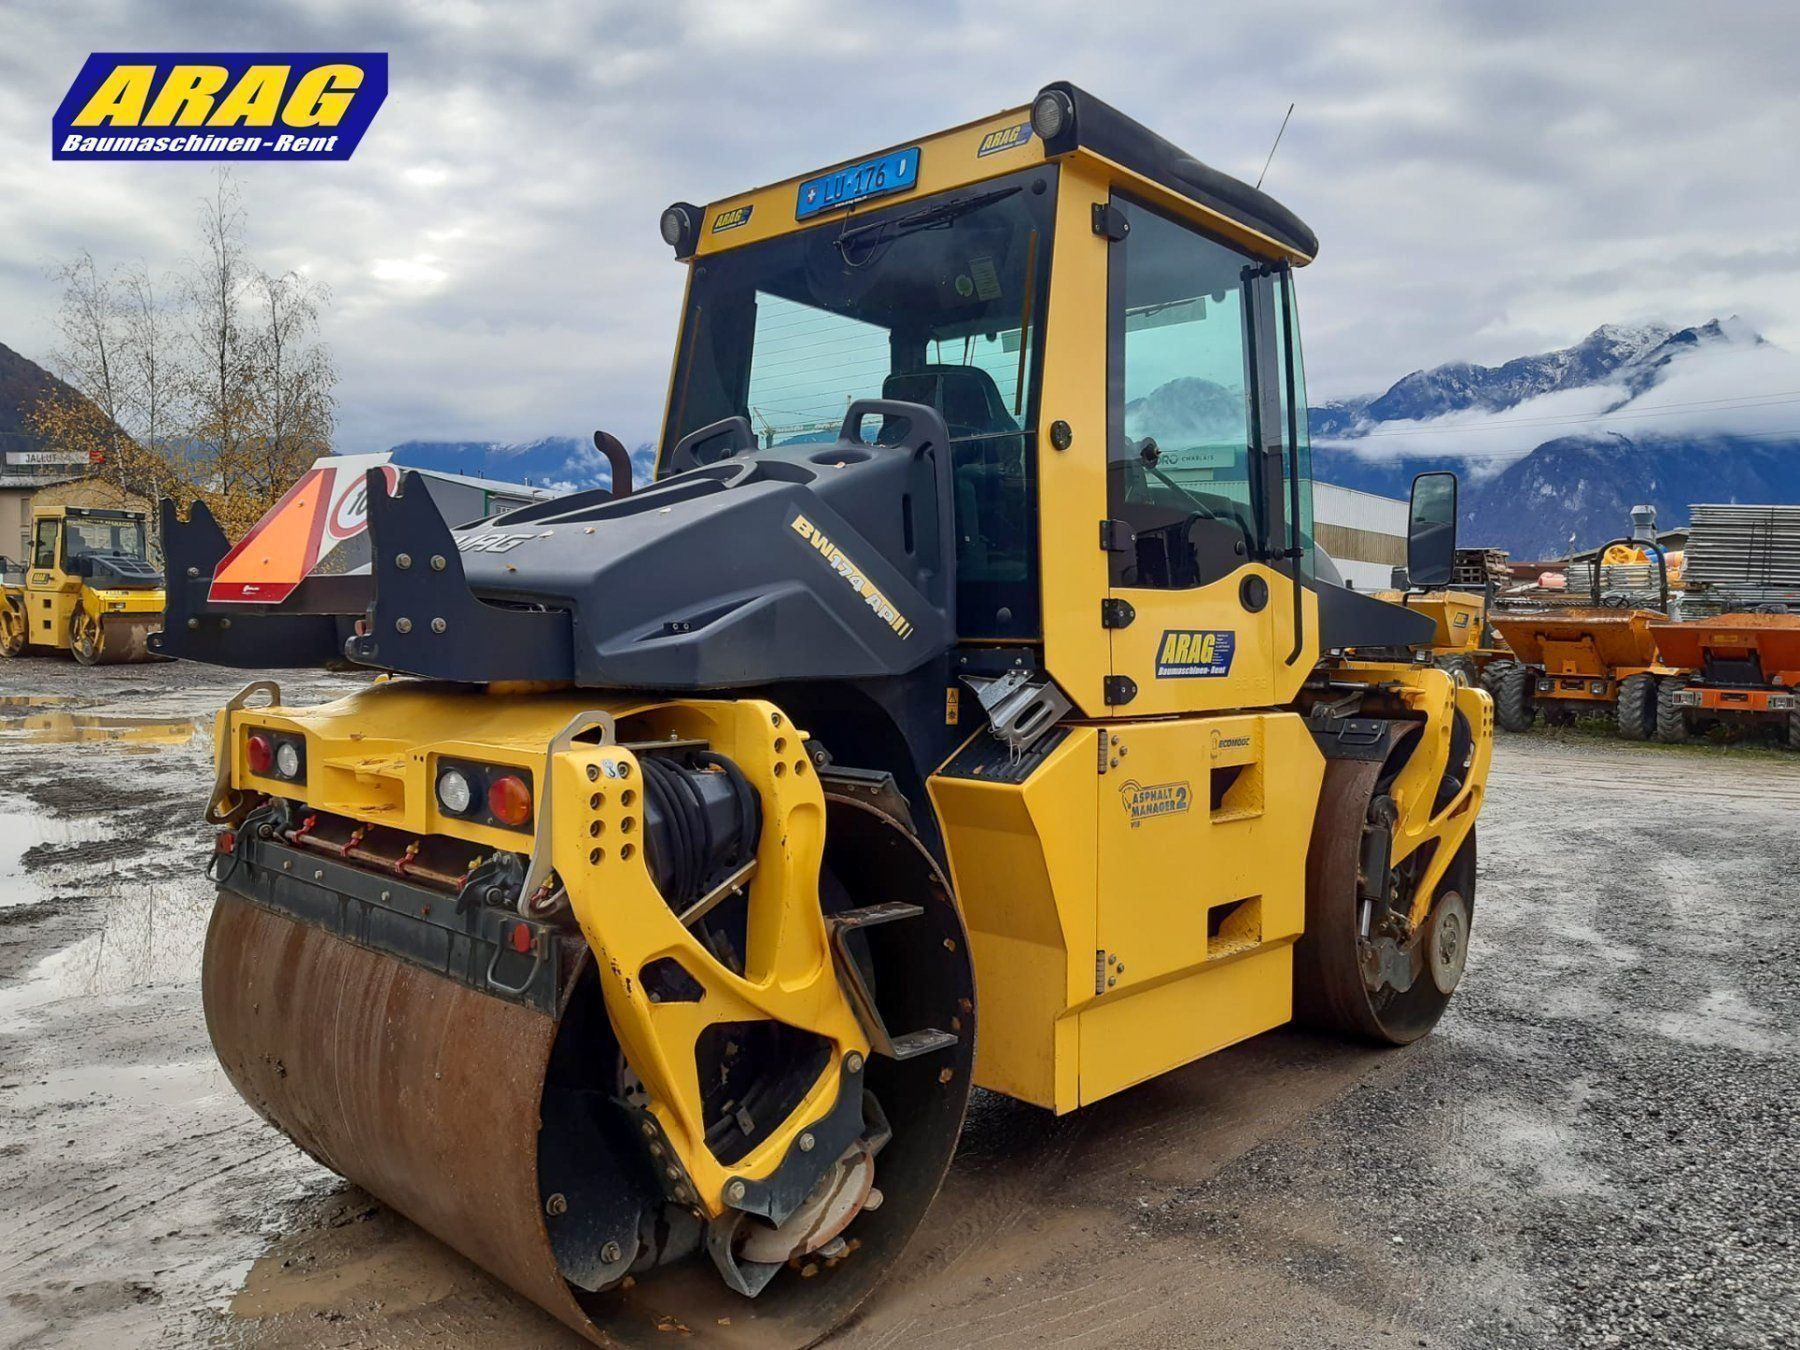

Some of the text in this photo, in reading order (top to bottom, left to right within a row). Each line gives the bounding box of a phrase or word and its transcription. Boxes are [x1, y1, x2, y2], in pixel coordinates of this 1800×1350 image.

[981, 125, 1022, 151] ARAG
[715, 208, 743, 228] ARAG
[1160, 633, 1216, 664] ARAG
[1131, 786, 1187, 818] MANAGER 2
[1132, 788, 1173, 804] ASPHALT
